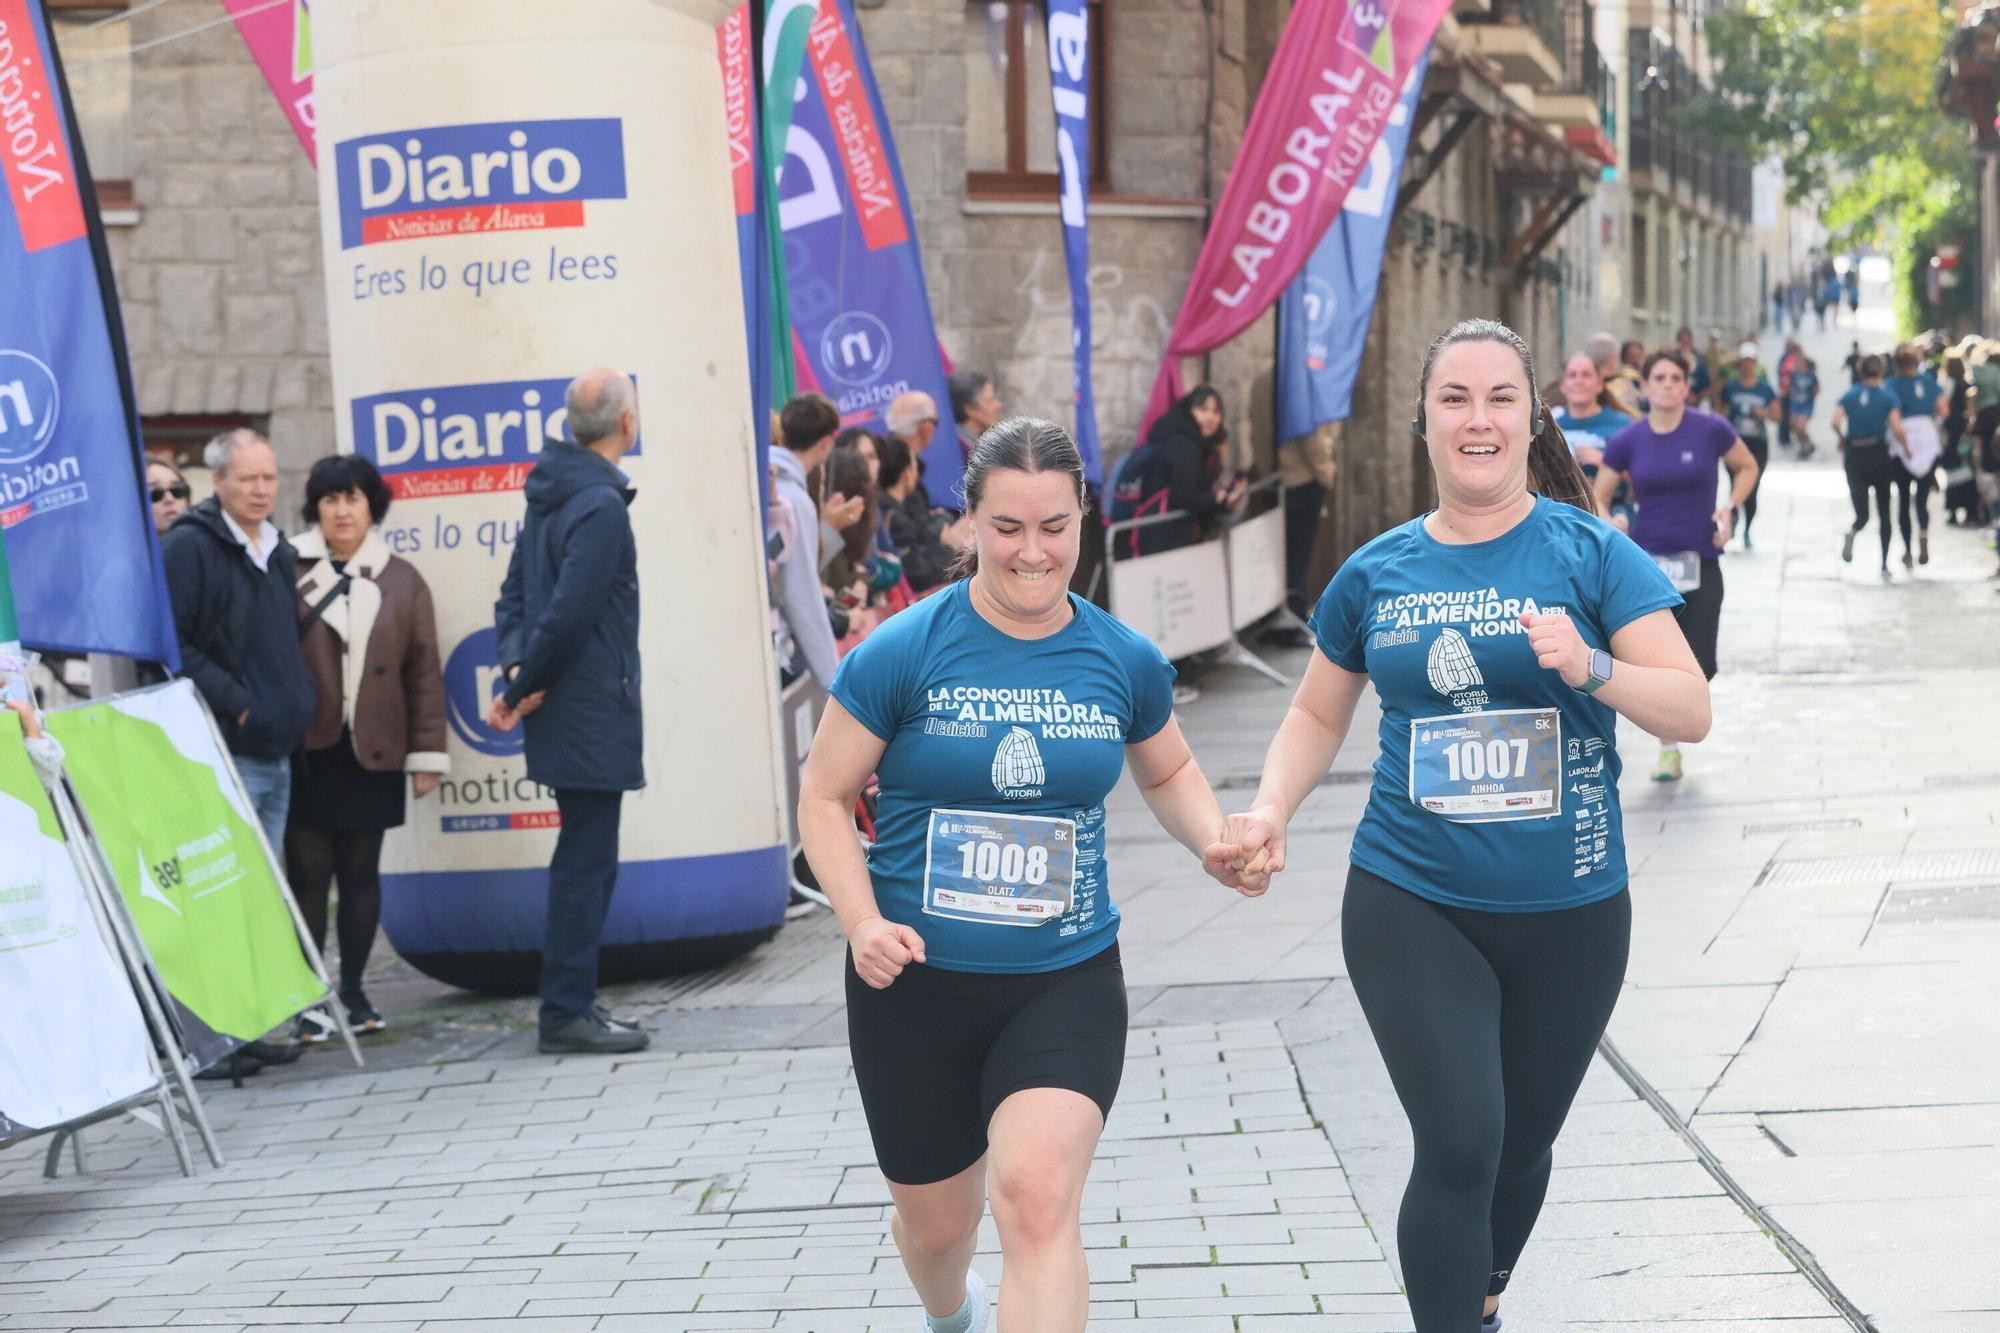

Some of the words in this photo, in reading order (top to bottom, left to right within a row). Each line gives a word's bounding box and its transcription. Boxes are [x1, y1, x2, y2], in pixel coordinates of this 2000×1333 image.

[1324, 80, 1394, 188] kutxa
[357, 130, 582, 210] Diario
[1211, 65, 1366, 308] LABORAL
[386, 212, 453, 240] Noticias
[458, 207, 480, 231] de
[483, 204, 546, 230] Álava
[354, 264, 406, 299] Eres
[420, 256, 447, 290] lo
[463, 258, 531, 297] que
[549, 247, 618, 281] lees
[401, 473, 468, 498] Noticias
[471, 469, 494, 491] de
[498, 463, 526, 490] Ál
[384, 527, 421, 553] res
[434, 514, 461, 550] lo
[477, 520, 522, 557] qu
[1378, 599, 1392, 614] LA
[1395, 587, 1500, 610] CONQUISTA
[1377, 615, 1387, 624] DE
[1387, 611, 1398, 620] LA
[1395, 597, 1540, 629] ALMENDRA
[1381, 628, 1419, 648] Edición
[928, 687, 951, 702] LA
[953, 686, 1066, 704] CONQUISTA
[1450, 689, 1488, 699] VITORIA
[1453, 697, 1490, 706] GASTEIZ
[929, 702, 942, 712] DE
[945, 701, 960, 710] LA
[958, 703, 1104, 724] ALMENDRA
[937, 721, 987, 737] Edición
[1042, 724, 1121, 740] KONKISTA
[1535, 719, 1551, 730] 5K
[1443, 738, 1529, 781] 1007
[1003, 789, 1042, 798] VITORIA
[1470, 784, 1505, 795] AINHOA
[1055, 830, 1068, 841] 5K
[957, 841, 1048, 885] 1008
[987, 886, 1016, 897] OLATZ
